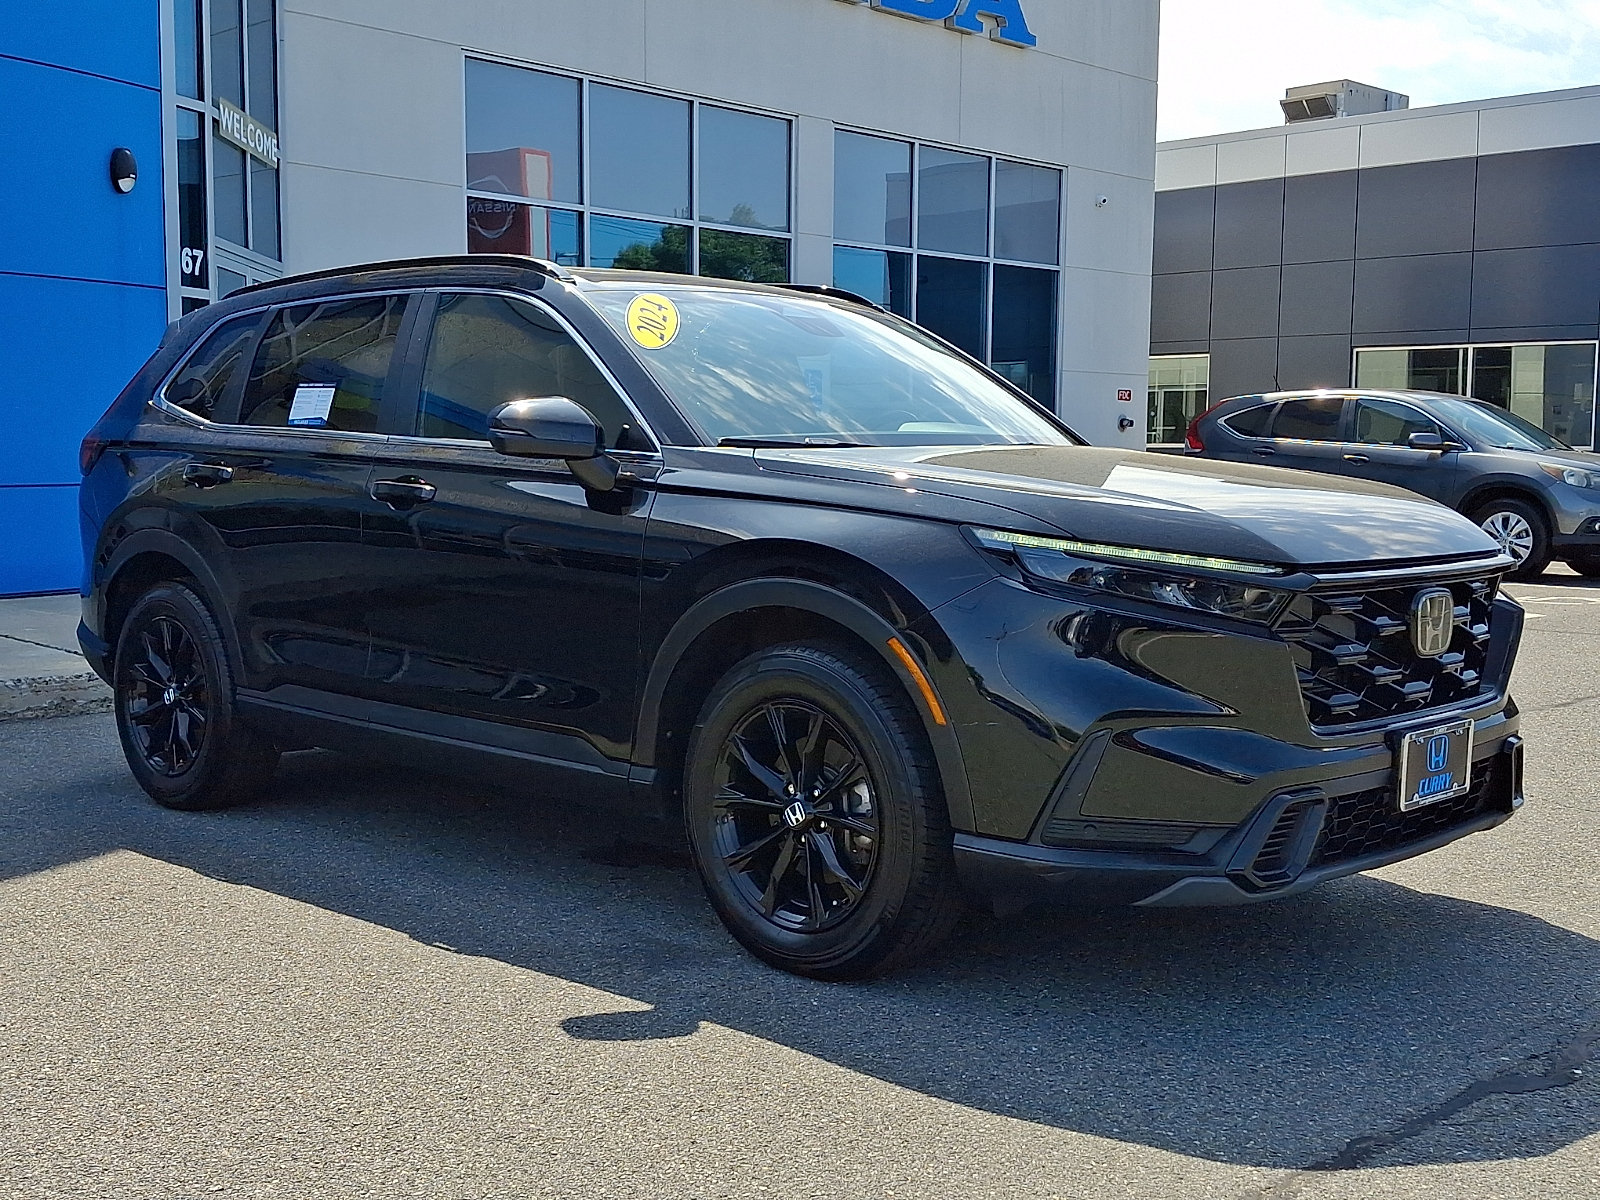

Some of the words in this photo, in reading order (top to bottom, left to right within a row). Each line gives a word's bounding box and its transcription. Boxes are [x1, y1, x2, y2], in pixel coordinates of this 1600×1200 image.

[220, 103, 277, 161] WELCOME
[182, 247, 204, 275] 67
[637, 297, 669, 342] 2024
[1118, 390, 1131, 400] FDC
[1418, 771, 1454, 796] CURRY
